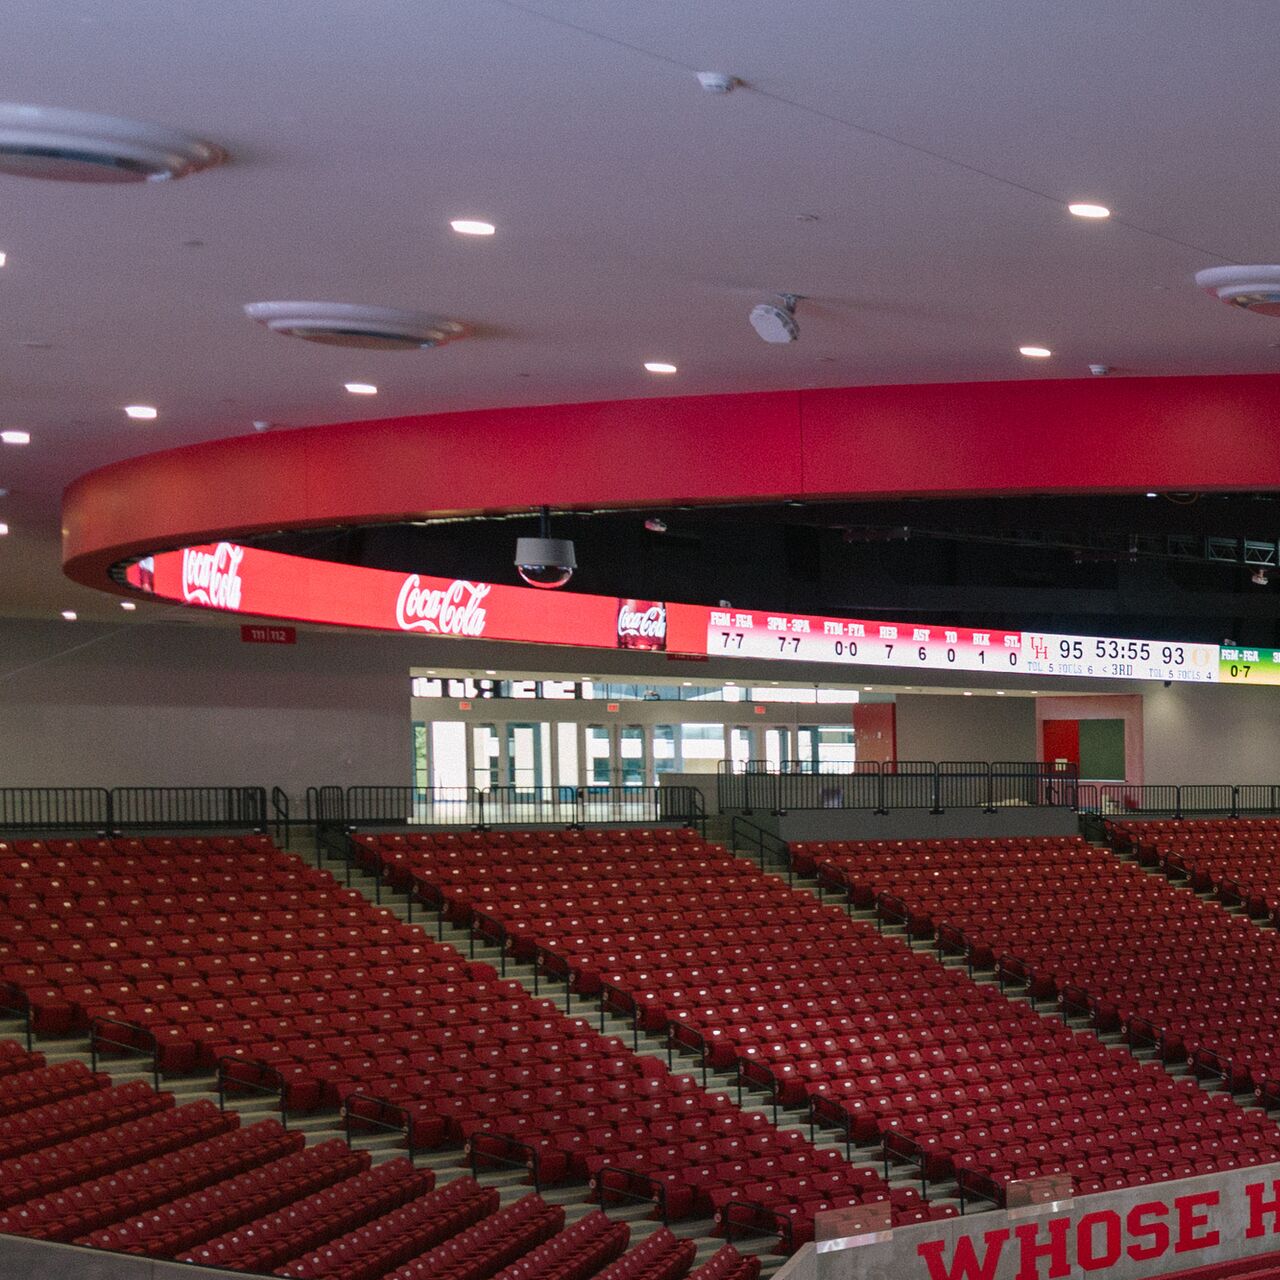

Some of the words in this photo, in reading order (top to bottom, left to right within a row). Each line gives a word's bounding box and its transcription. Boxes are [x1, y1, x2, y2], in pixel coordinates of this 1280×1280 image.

[396, 574, 490, 637] Coca-Cola
[912, 628, 930, 642] AST
[944, 630, 958, 644] TO
[972, 633, 990, 646] BLK
[1003, 634, 1021, 648] STL
[885, 644, 894, 659] 7
[918, 646, 927, 661] 6
[947, 648, 956, 663] 0
[978, 651, 985, 664] 1
[1009, 652, 1017, 666] 0
[1059, 640, 1083, 659] 95
[1095, 640, 1150, 661] 53:55
[1162, 646, 1184, 665] 93
[1048, 663, 1054, 672] 5
[1087, 665, 1093, 675] 6
[1112, 664, 1133, 676] 3RD
[1168, 670, 1174, 679] 5
[1206, 672, 1212, 680] 4
